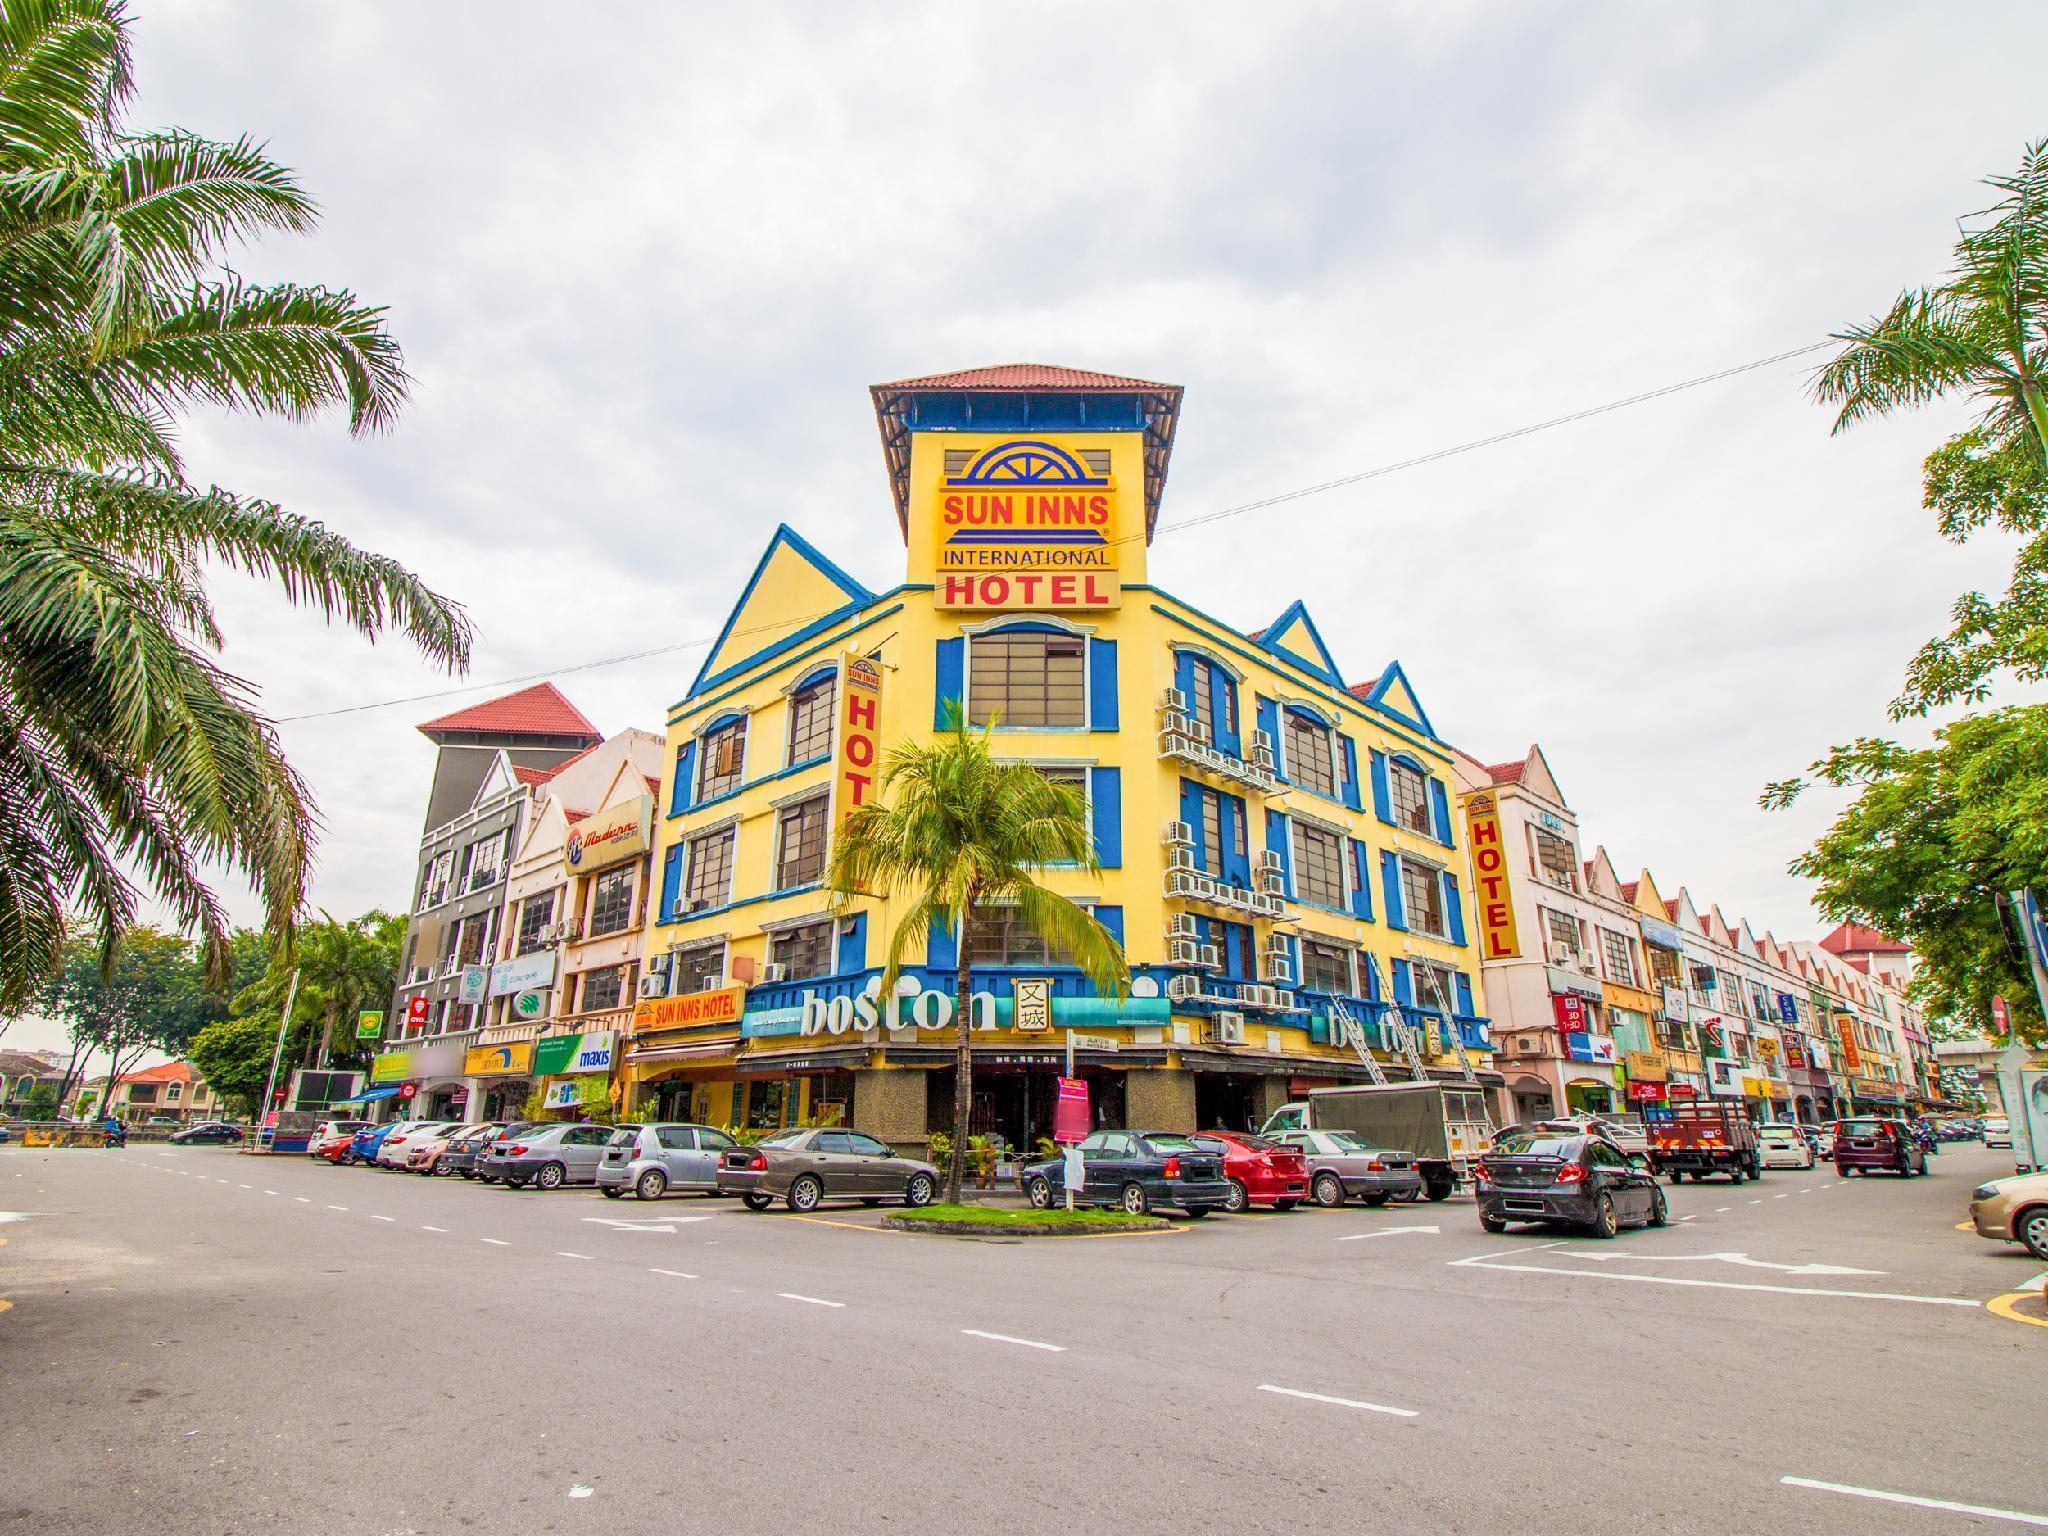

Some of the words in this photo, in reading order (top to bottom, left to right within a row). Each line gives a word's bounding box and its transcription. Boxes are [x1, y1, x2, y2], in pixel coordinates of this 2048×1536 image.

[944, 495, 1013, 524] SUN
[1026, 495, 1109, 524] INNS
[944, 550, 1110, 565] INTERNATIONAL
[945, 575, 1109, 605] HOTEL
[1473, 820, 1512, 957] HOTEL
[655, 1003, 676, 1025] SUN
[676, 998, 701, 1021] INNS
[702, 993, 736, 1018] HOTEL
[1020, 984, 1045, 1027] 又一城
[1567, 1011, 1580, 1021] 3D
[579, 1050, 610, 1068] maxis
